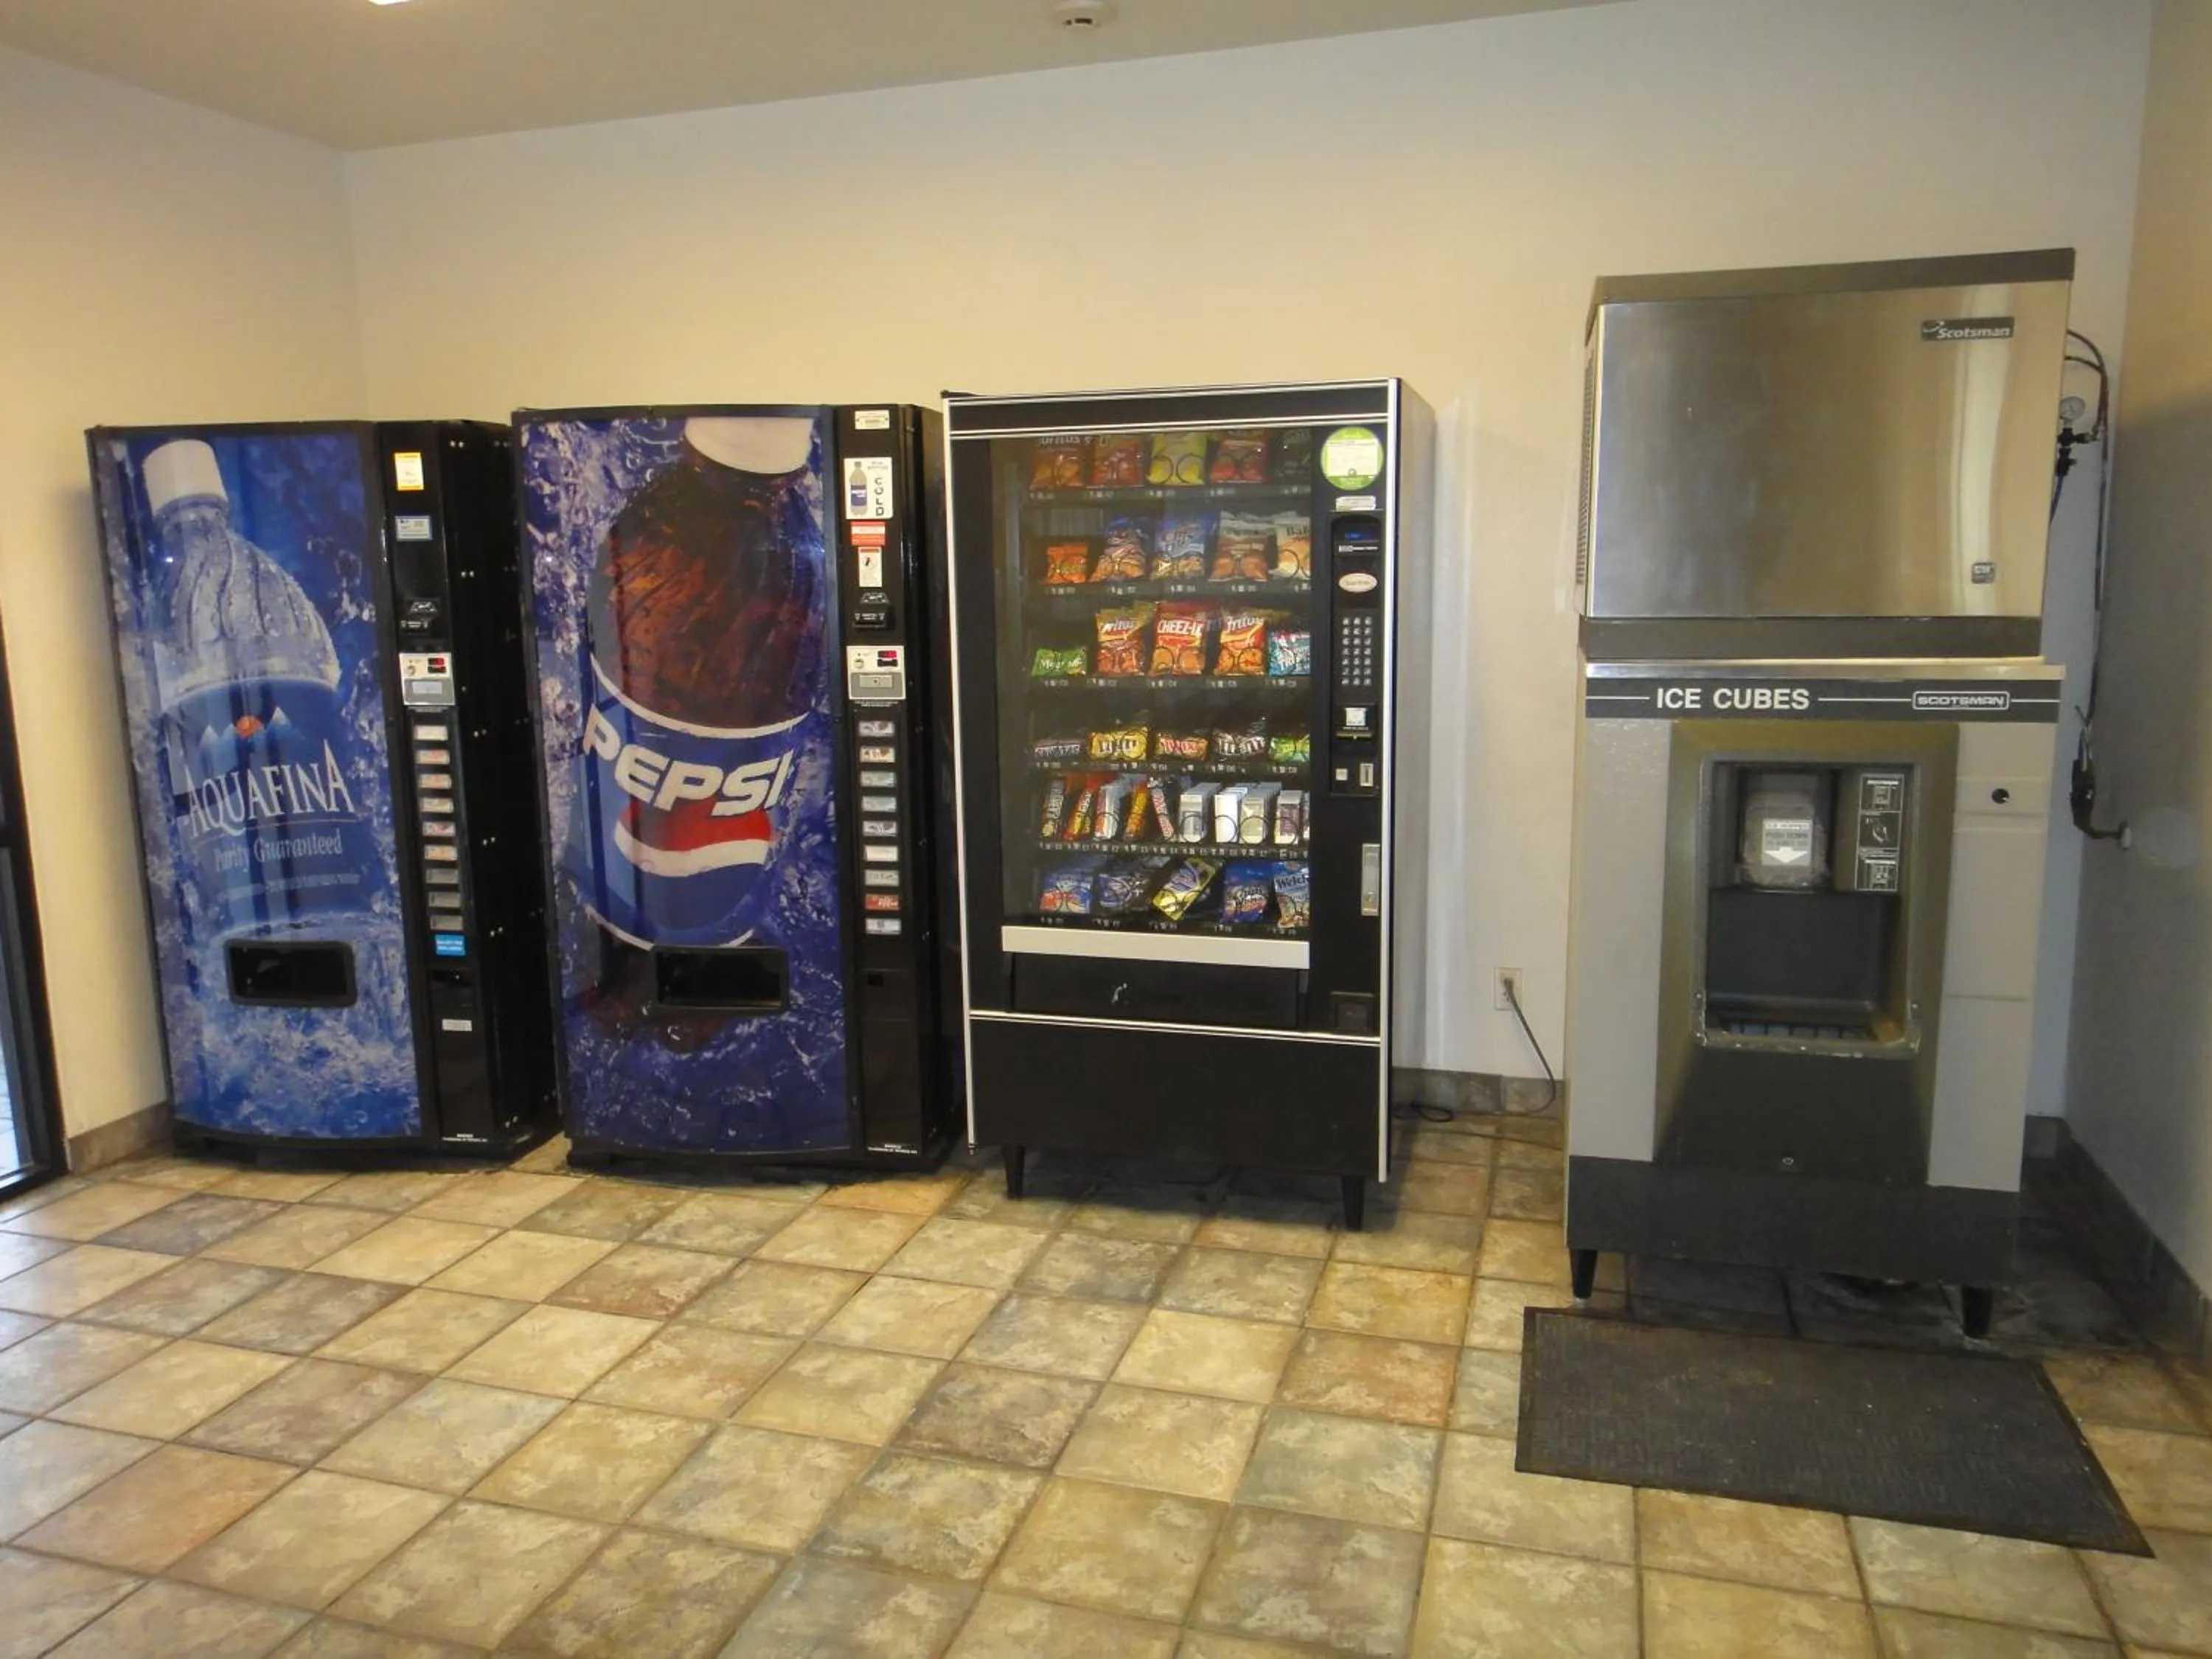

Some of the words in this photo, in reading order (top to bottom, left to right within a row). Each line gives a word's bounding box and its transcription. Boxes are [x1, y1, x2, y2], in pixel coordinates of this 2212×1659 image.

[1936, 327, 2011, 339] Scotsman
[1657, 687, 1703, 709] ICE
[1713, 687, 1810, 710] CUBES
[1917, 695, 2005, 706] SCOTSMAN
[582, 702, 795, 818] PEPSI
[186, 738, 355, 838] AQUAFINA
[254, 827, 343, 863] Guaranteed
